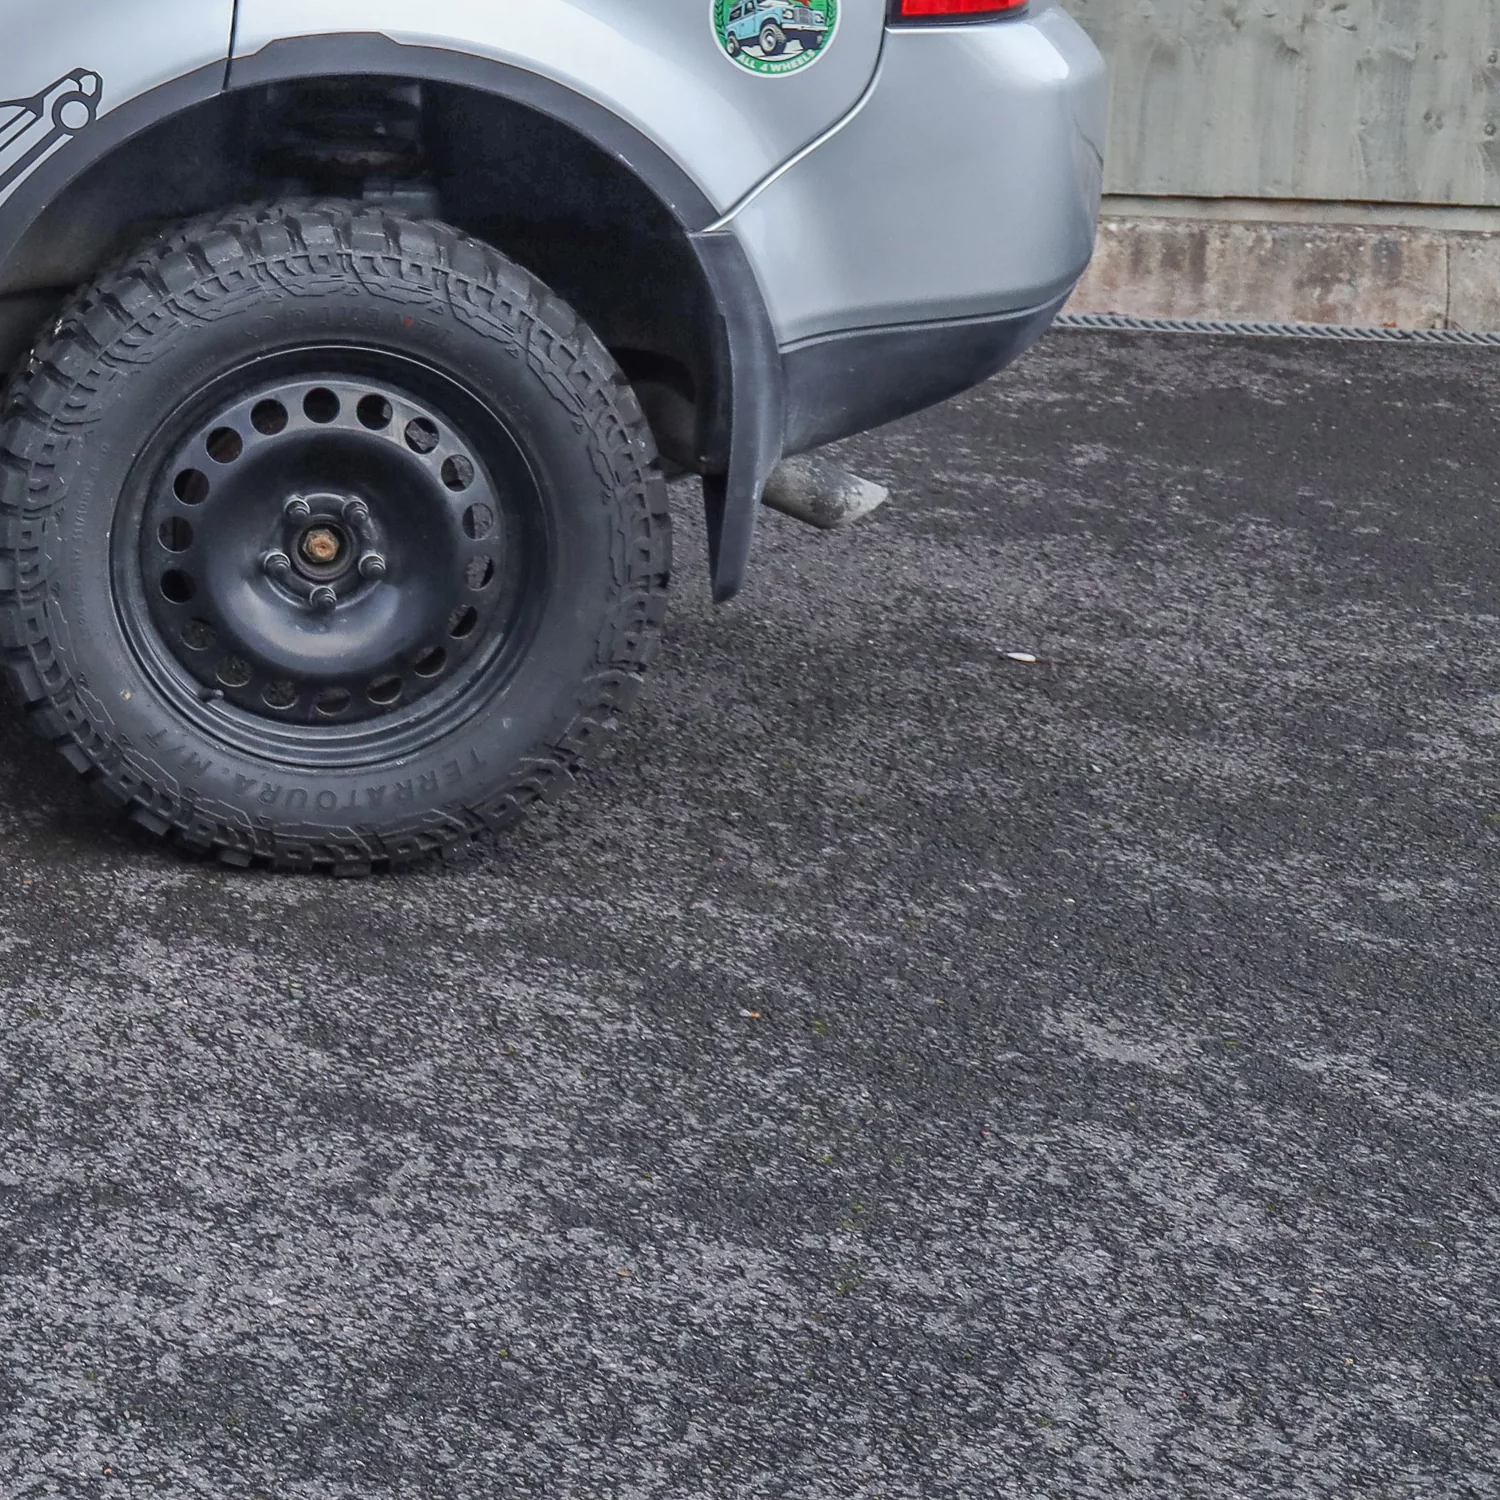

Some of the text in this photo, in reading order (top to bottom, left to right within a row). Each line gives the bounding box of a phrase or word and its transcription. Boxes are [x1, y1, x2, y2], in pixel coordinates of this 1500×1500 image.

[737, 48, 816, 72] ALL 4 WHEELS
